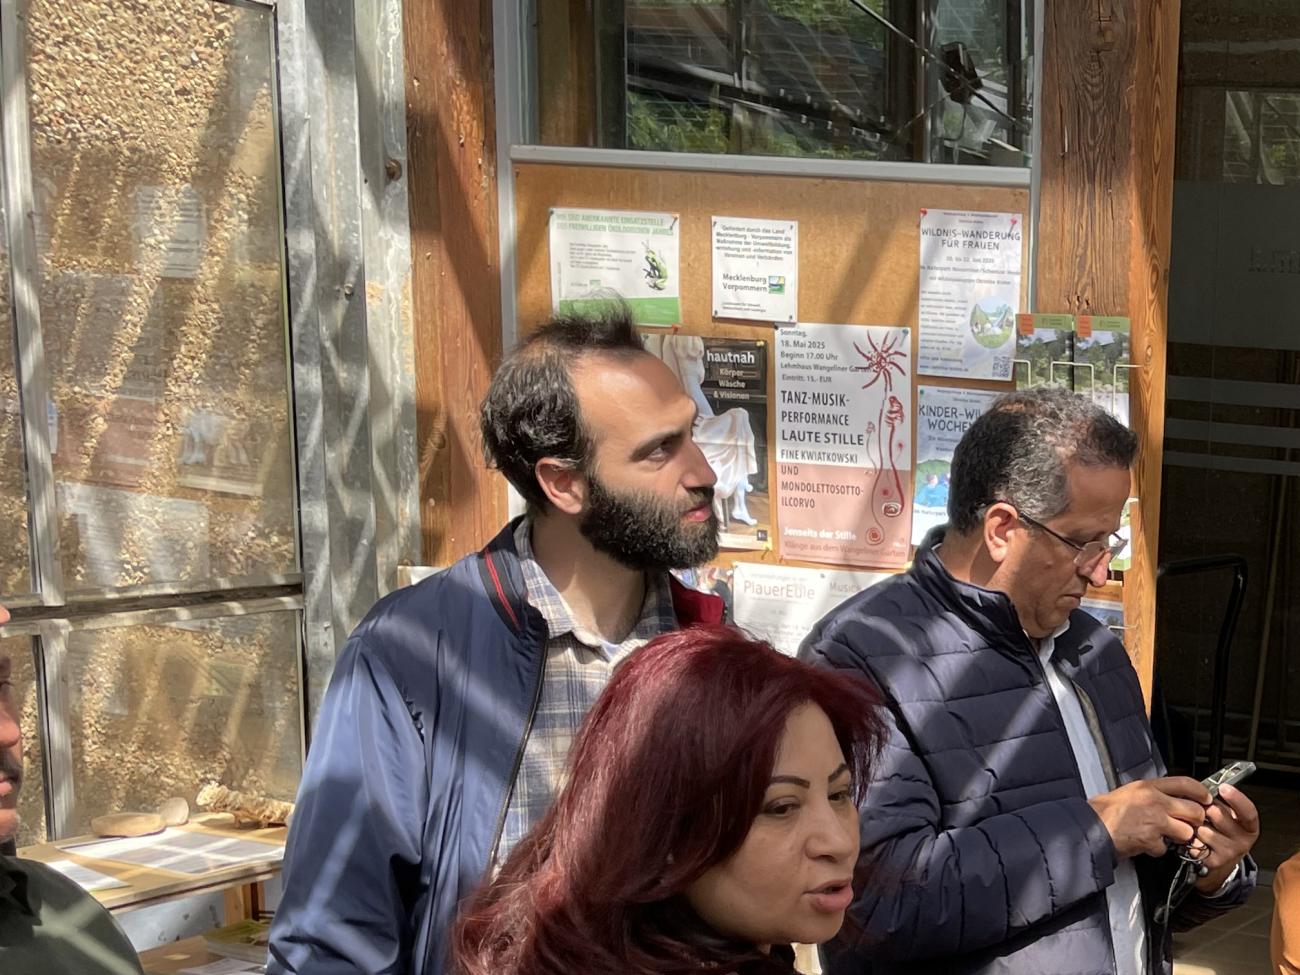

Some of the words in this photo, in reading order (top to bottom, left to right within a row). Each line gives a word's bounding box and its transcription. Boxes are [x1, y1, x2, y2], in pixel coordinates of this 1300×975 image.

[921, 228, 1021, 241] WILDNIS-WANDERUNG
[963, 240, 1000, 250] FRAUEN
[723, 273, 767, 284] Mecklenburg
[723, 282, 767, 292] Vorpommern
[781, 339, 792, 348] 18.
[793, 340, 806, 348] Mai
[808, 341, 825, 350] 2025
[706, 350, 755, 365] hautnah
[781, 351, 804, 361] Beginn
[806, 352, 824, 360] 17.00
[825, 352, 838, 360] Uhr
[719, 368, 744, 378] Körper
[781, 362, 812, 371] Lehmhaus
[813, 364, 848, 373] Wangeliner
[718, 379, 746, 389] Wäsche
[713, 391, 719, 399] &
[719, 391, 750, 400] Visionen
[781, 390, 850, 407] TANZ-MUSIK-
[781, 410, 849, 426] PERFORMANCE
[781, 429, 822, 443] LAUTE
[824, 431, 864, 446] STILLE
[781, 449, 800, 460] FINE
[801, 450, 858, 464] KWIATKOWSKI
[781, 465, 799, 475] UND
[781, 481, 864, 496] MONDOLETTOSOTTO-
[781, 496, 815, 509] ILCORVO
[784, 527, 818, 538] Jenseits
[819, 529, 833, 538] der
[834, 530, 857, 541] Stille
[784, 540, 809, 551] Klänge
[810, 542, 822, 550] aus
[823, 542, 839, 552] dem
[743, 579, 816, 600] PlauerEule
